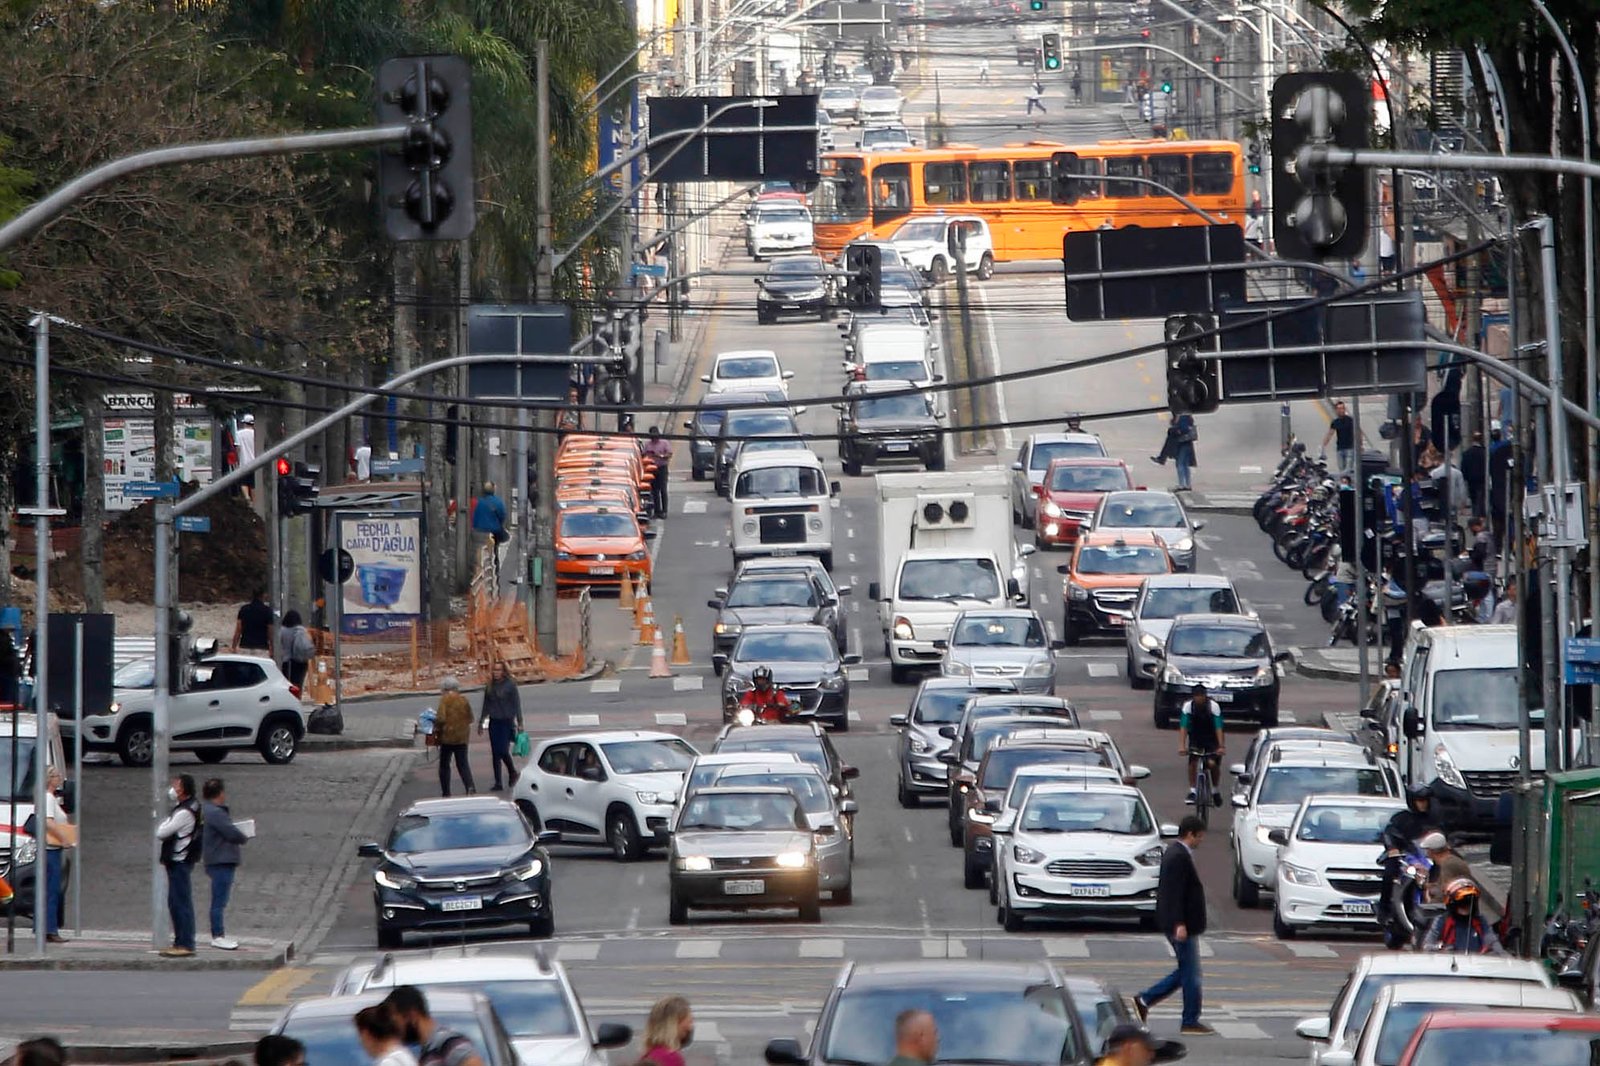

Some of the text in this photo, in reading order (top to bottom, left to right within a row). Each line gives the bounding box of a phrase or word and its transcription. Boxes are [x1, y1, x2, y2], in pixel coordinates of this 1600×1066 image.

[108, 396, 155, 407] BANCA
[357, 522, 401, 536] FECHA A
[346, 538, 371, 550] CAIXA
